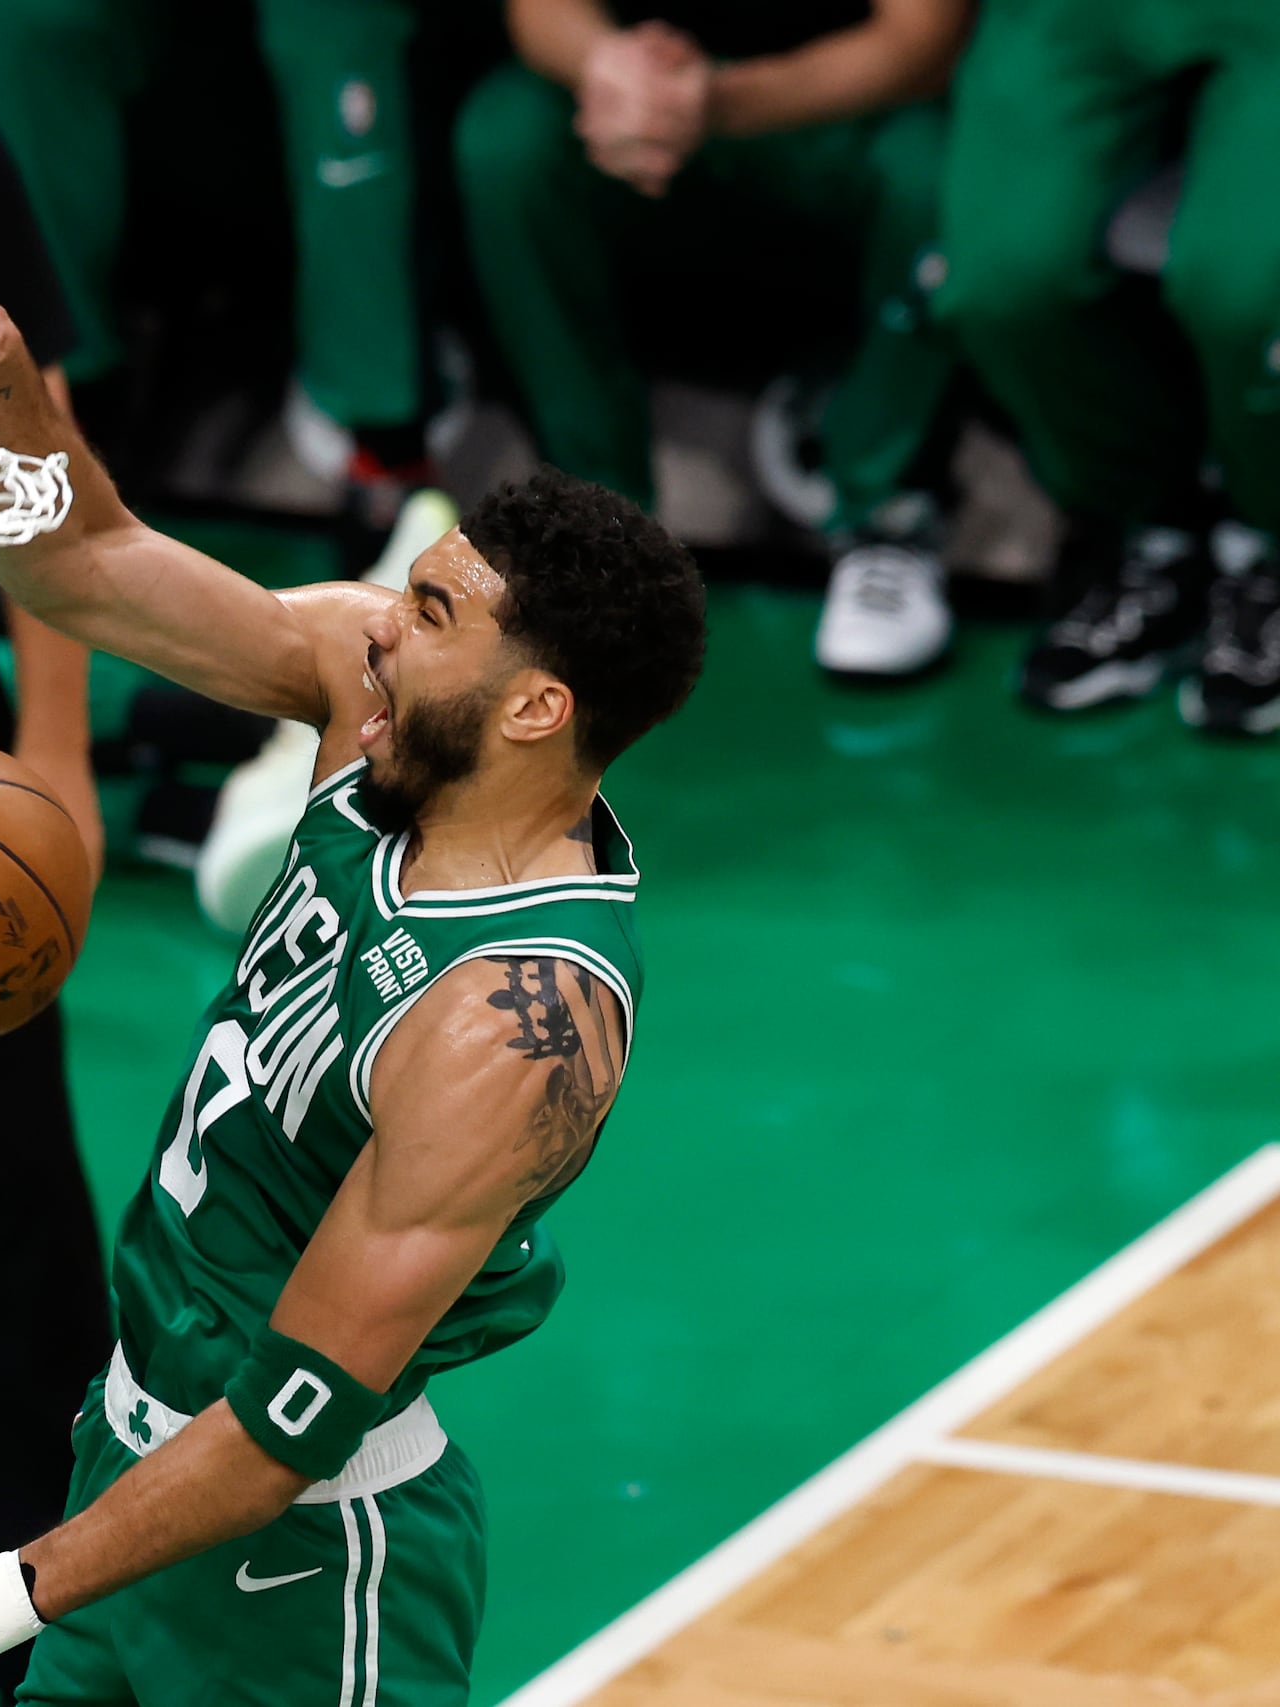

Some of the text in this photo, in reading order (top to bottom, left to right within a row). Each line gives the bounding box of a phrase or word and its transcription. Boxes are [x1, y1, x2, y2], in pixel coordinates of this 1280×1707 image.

[237, 839, 349, 1143] OSTON
[360, 945, 403, 1004] PRINT
[381, 927, 429, 992] VISTA
[158, 1019, 252, 1219] 0
[267, 1367, 333, 1436] 0
